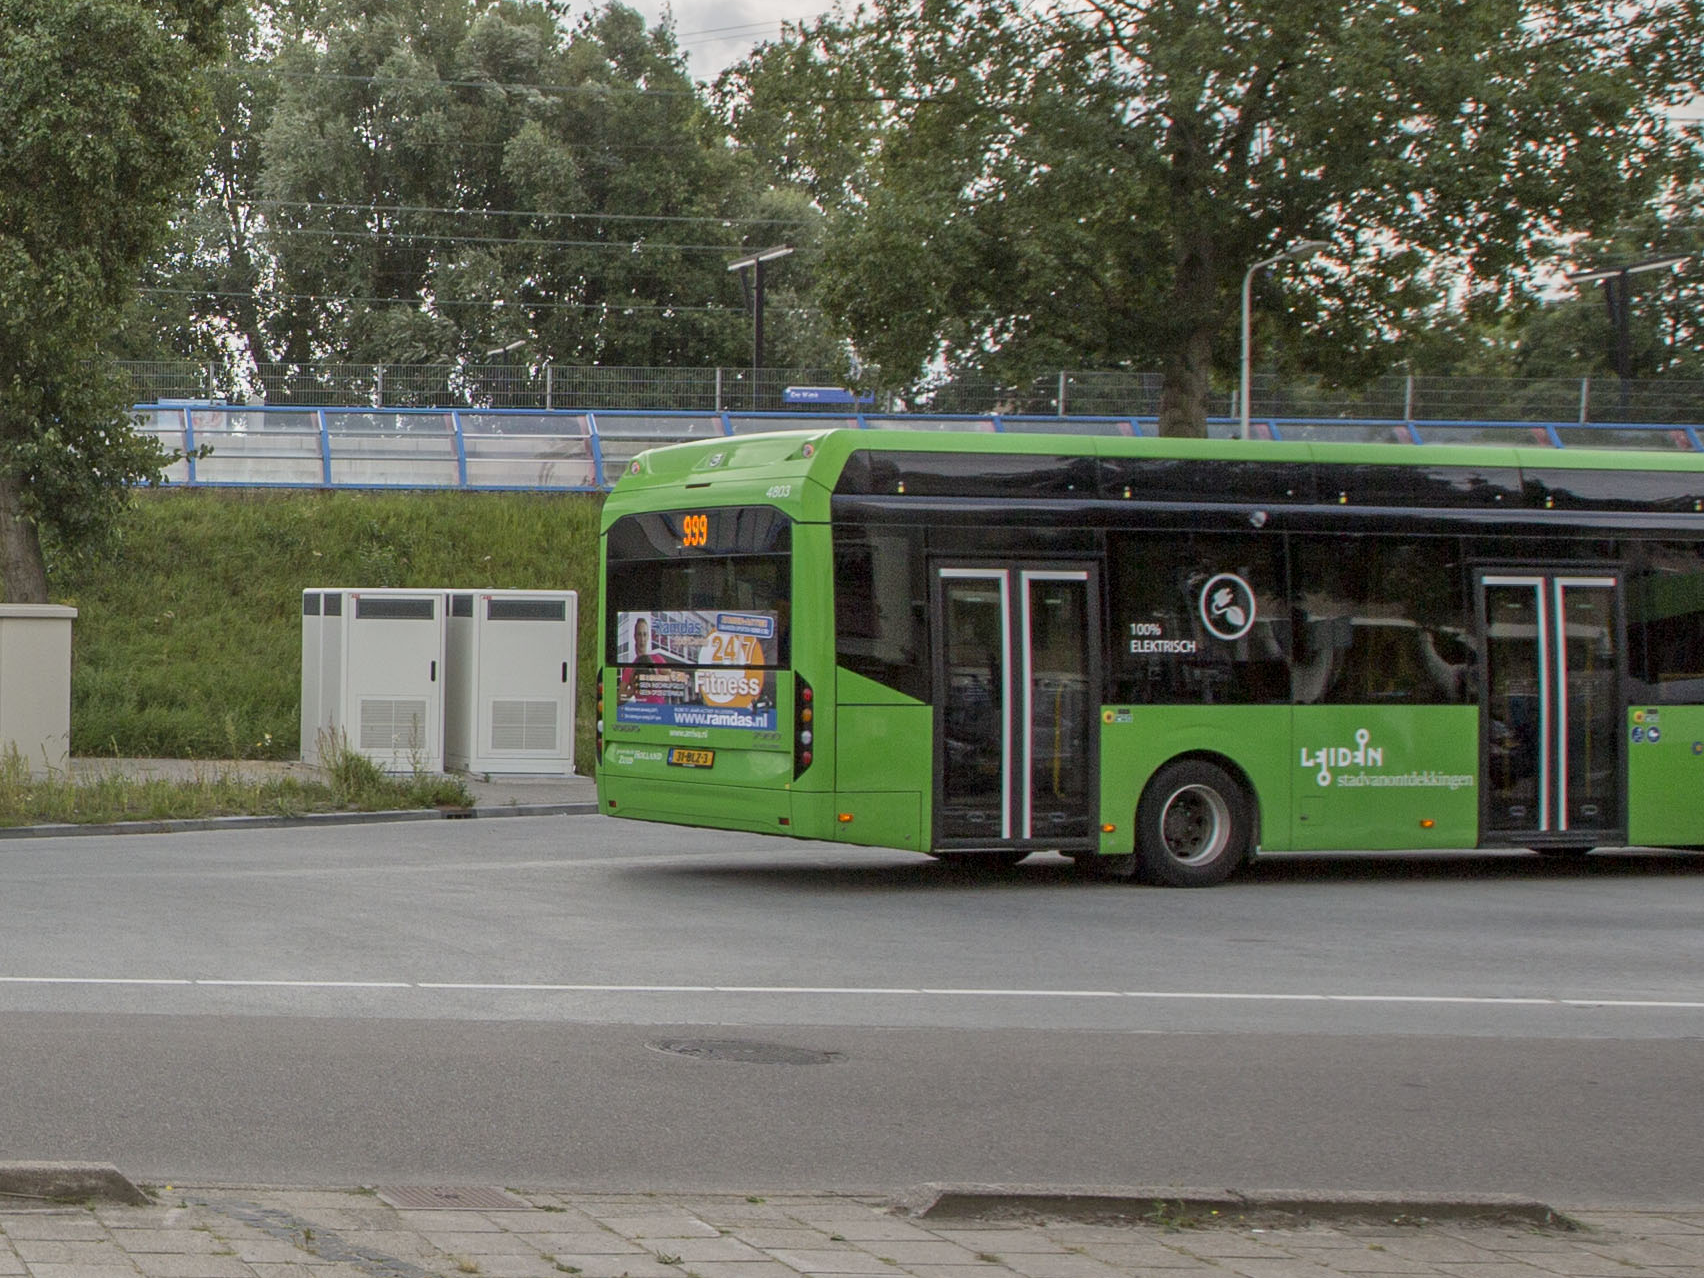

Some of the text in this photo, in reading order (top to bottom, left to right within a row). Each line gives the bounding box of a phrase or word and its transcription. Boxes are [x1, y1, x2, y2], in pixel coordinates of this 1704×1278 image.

[766, 485, 791, 498] 4803
[683, 515, 708, 546] 999
[1130, 624, 1161, 636] 100%
[1130, 641, 1196, 653] ELEKTRISCH
[695, 671, 760, 696] Fitness
[674, 711, 768, 728] www.ramdas.nl
[676, 751, 709, 764] 31-BLZ-3
